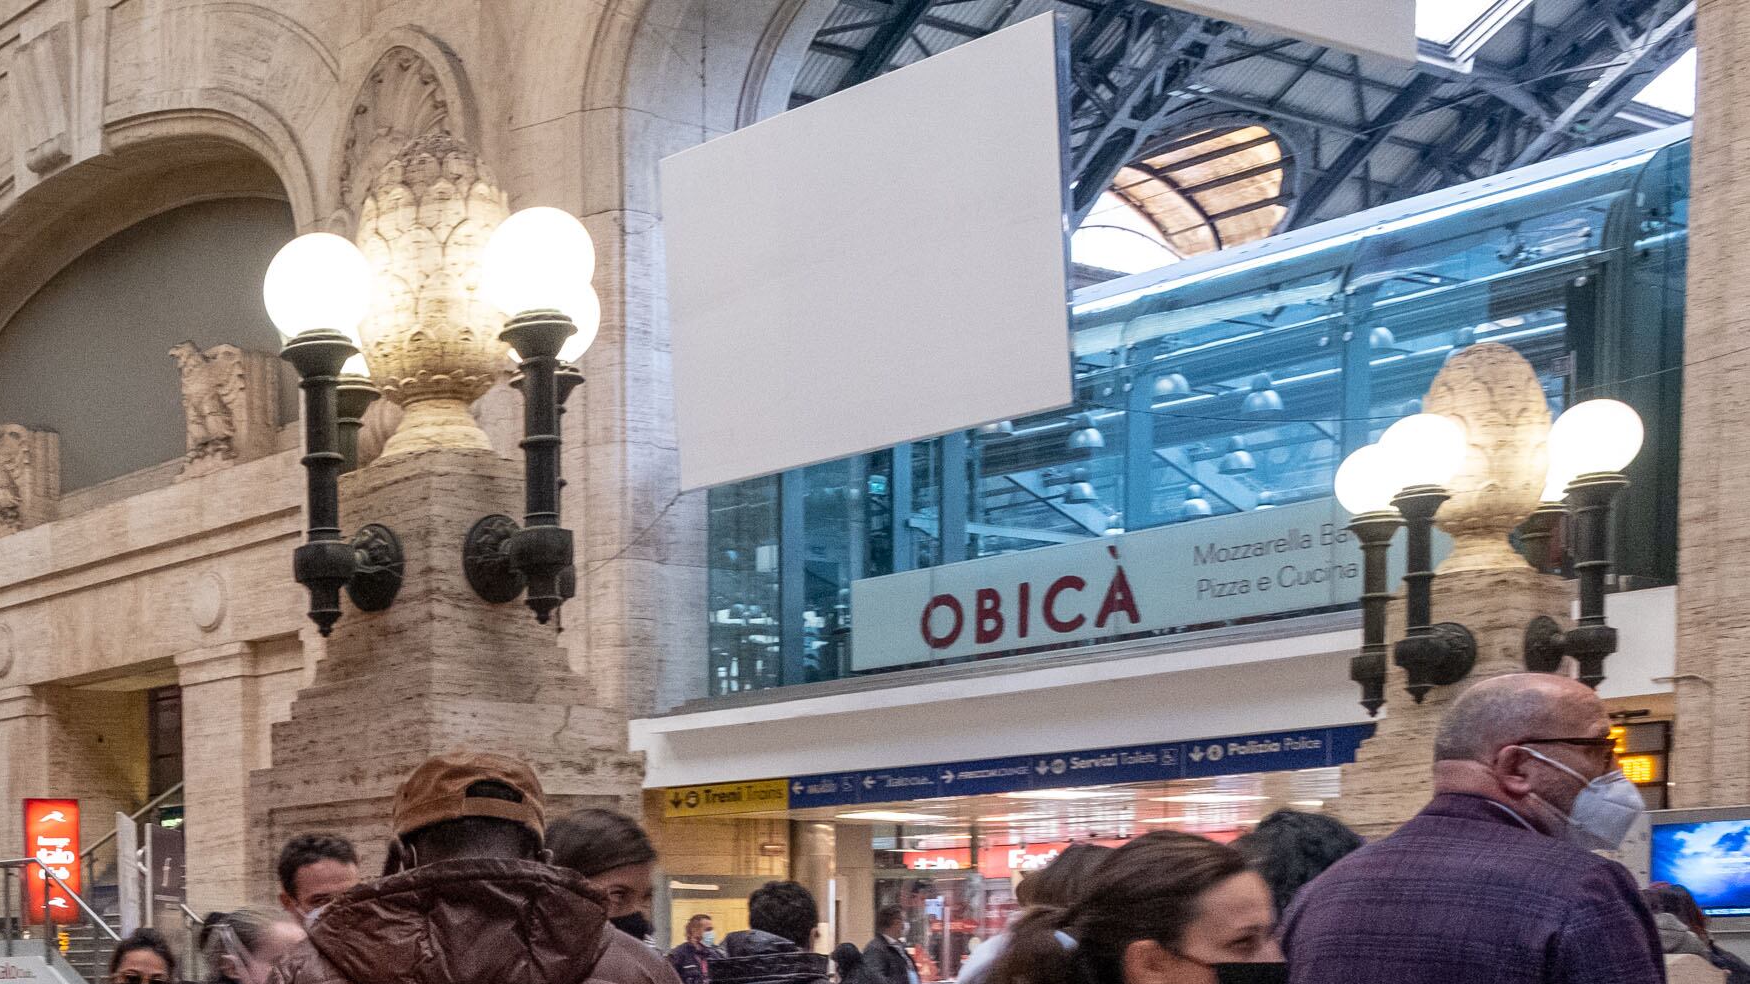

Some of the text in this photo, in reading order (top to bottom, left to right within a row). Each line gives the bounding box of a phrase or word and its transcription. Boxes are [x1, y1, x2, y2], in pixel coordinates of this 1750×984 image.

[1193, 526, 1313, 567] Mozzarella
[1195, 560, 1359, 601] Pizza e Cucina
[921, 545, 1141, 649] OBICÀ
[1227, 737, 1323, 757] Polizia Police
[1070, 755, 1118, 770] Servizi
[704, 787, 743, 804] Treni
